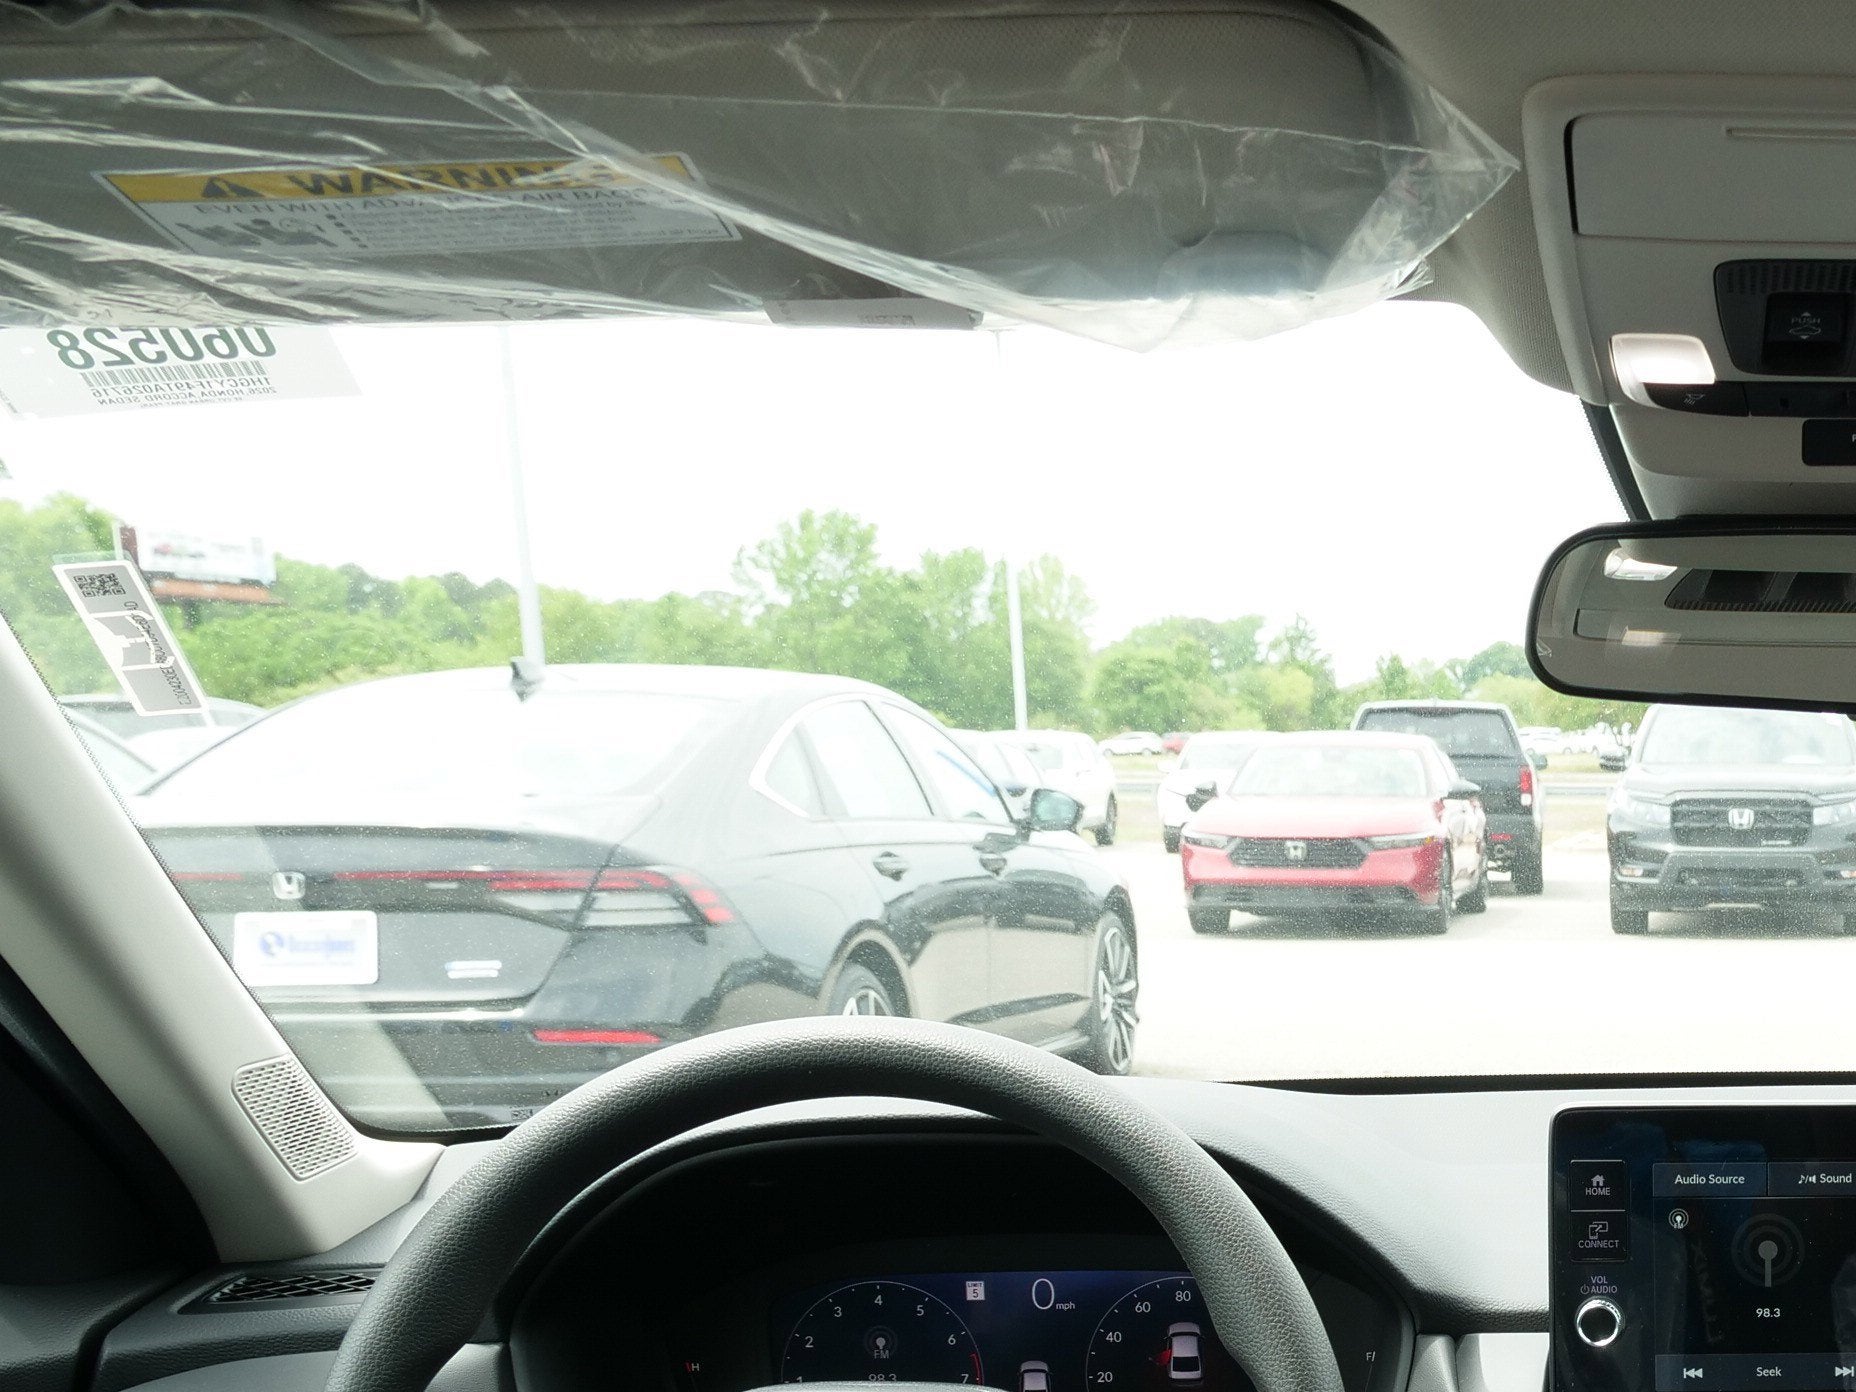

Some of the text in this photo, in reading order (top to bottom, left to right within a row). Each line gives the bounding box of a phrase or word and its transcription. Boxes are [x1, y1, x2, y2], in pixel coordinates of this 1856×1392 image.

[1674, 1174, 1745, 1185] Audio Source
[1820, 1173, 1852, 1184] Sound
[1585, 1187, 1610, 1196] HOME
[1578, 1240, 1619, 1248] CONNECT
[1591, 1275, 1608, 1284] VOL
[971, 1289, 979, 1299] 5
[1032, 1278, 1075, 1311] 0 mph
[1590, 1285, 1618, 1294] AUDIO
[874, 1294, 882, 1306] 4
[1175, 1290, 1191, 1302] 80
[834, 1306, 842, 1317] 3
[916, 1305, 924, 1316] 5
[1135, 1301, 1151, 1313] 60
[1756, 1307, 1781, 1320] 98.3
[805, 1336, 814, 1348] 2
[948, 1334, 956, 1345] 6
[1106, 1331, 1122, 1342] 40
[873, 1350, 889, 1359] FM
[691, 1363, 699, 1371] H
[1756, 1366, 1782, 1378] Seek
[961, 1374, 969, 1384] 7
[1097, 1372, 1113, 1383] 20
